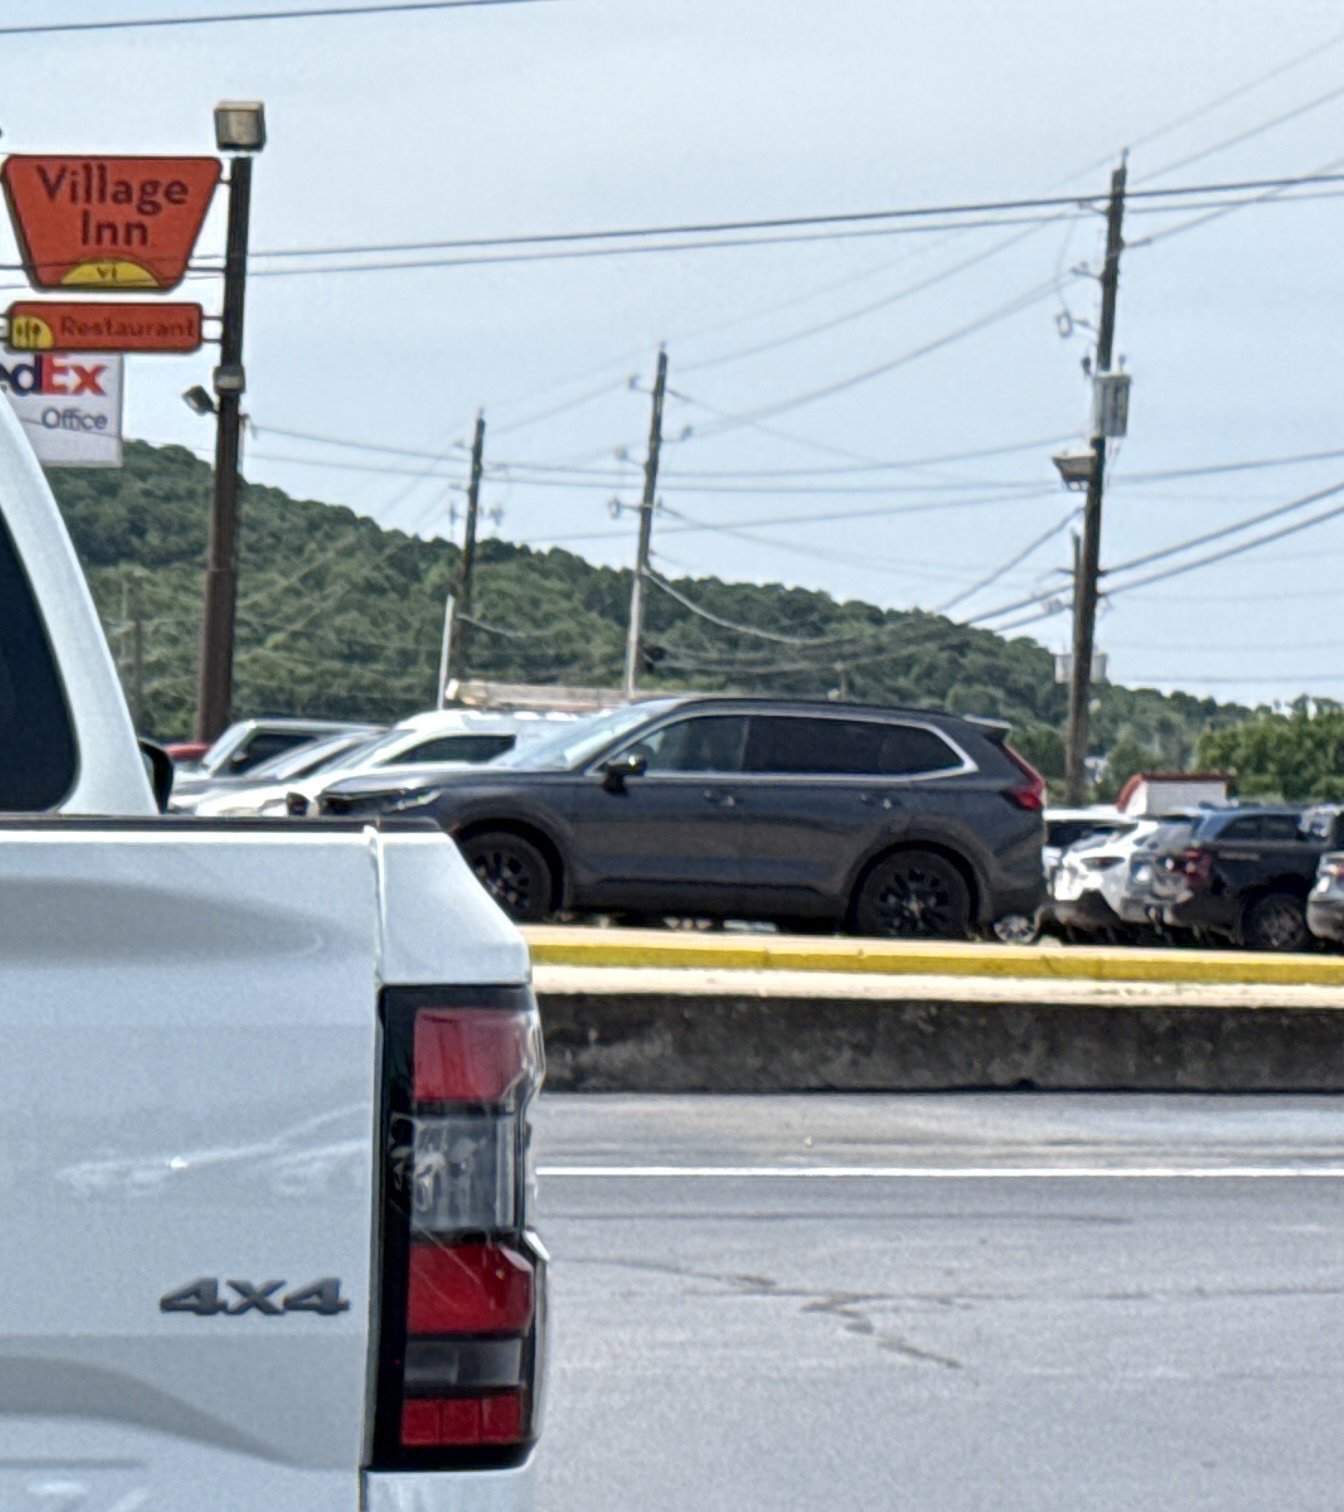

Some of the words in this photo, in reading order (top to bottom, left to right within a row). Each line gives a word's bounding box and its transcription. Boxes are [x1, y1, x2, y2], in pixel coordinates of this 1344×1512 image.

[36, 163, 190, 216] Village
[81, 211, 149, 246] Inn
[61, 316, 196, 339] Restaurant
[41, 406, 108, 430] Office
